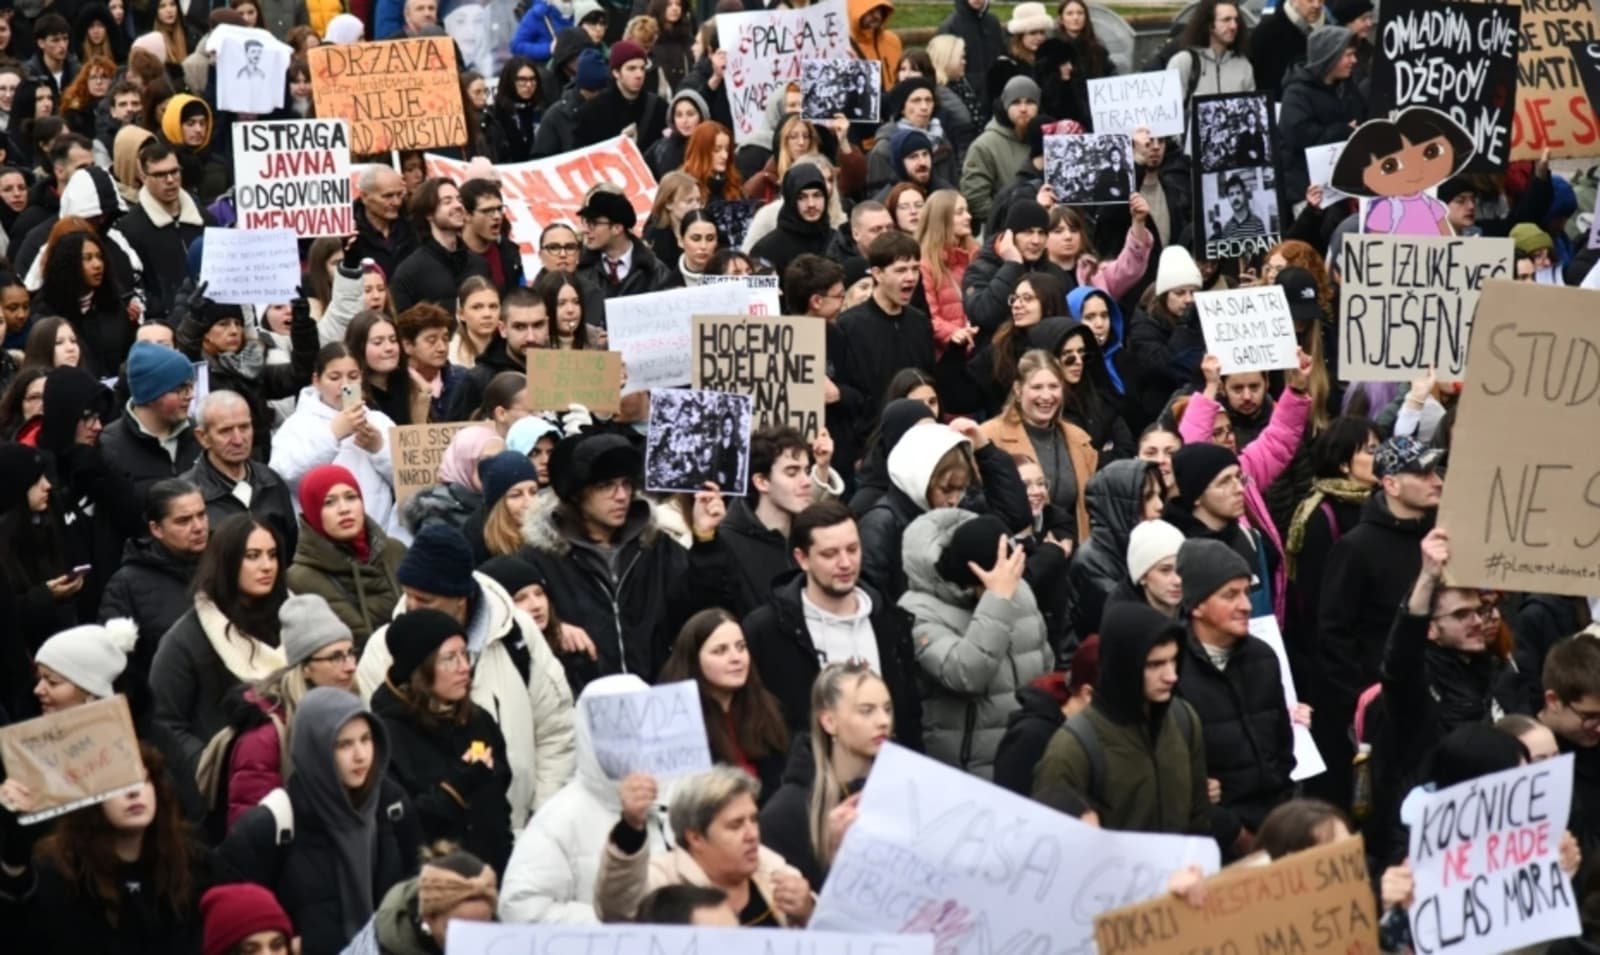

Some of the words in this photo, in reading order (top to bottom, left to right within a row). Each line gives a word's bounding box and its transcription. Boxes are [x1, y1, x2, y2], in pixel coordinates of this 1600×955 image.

[1394, 53, 1491, 106] DŽEPOVI
[350, 87, 427, 122] NIJE
[242, 122, 347, 152] ISTRAGA
[259, 150, 336, 179] JAVNA
[239, 178, 351, 210] ODGOVORNI
[246, 206, 351, 235] IMENOVANI
[1344, 240, 1385, 287] NE
[699, 318, 794, 355] HOĆEMO
[1480, 322, 1600, 407] STUD
[1484, 463, 1573, 548] NE
[1417, 771, 1550, 863] KOČNICE
[1486, 823, 1551, 874] RADE
[1503, 860, 1571, 928] MORA
